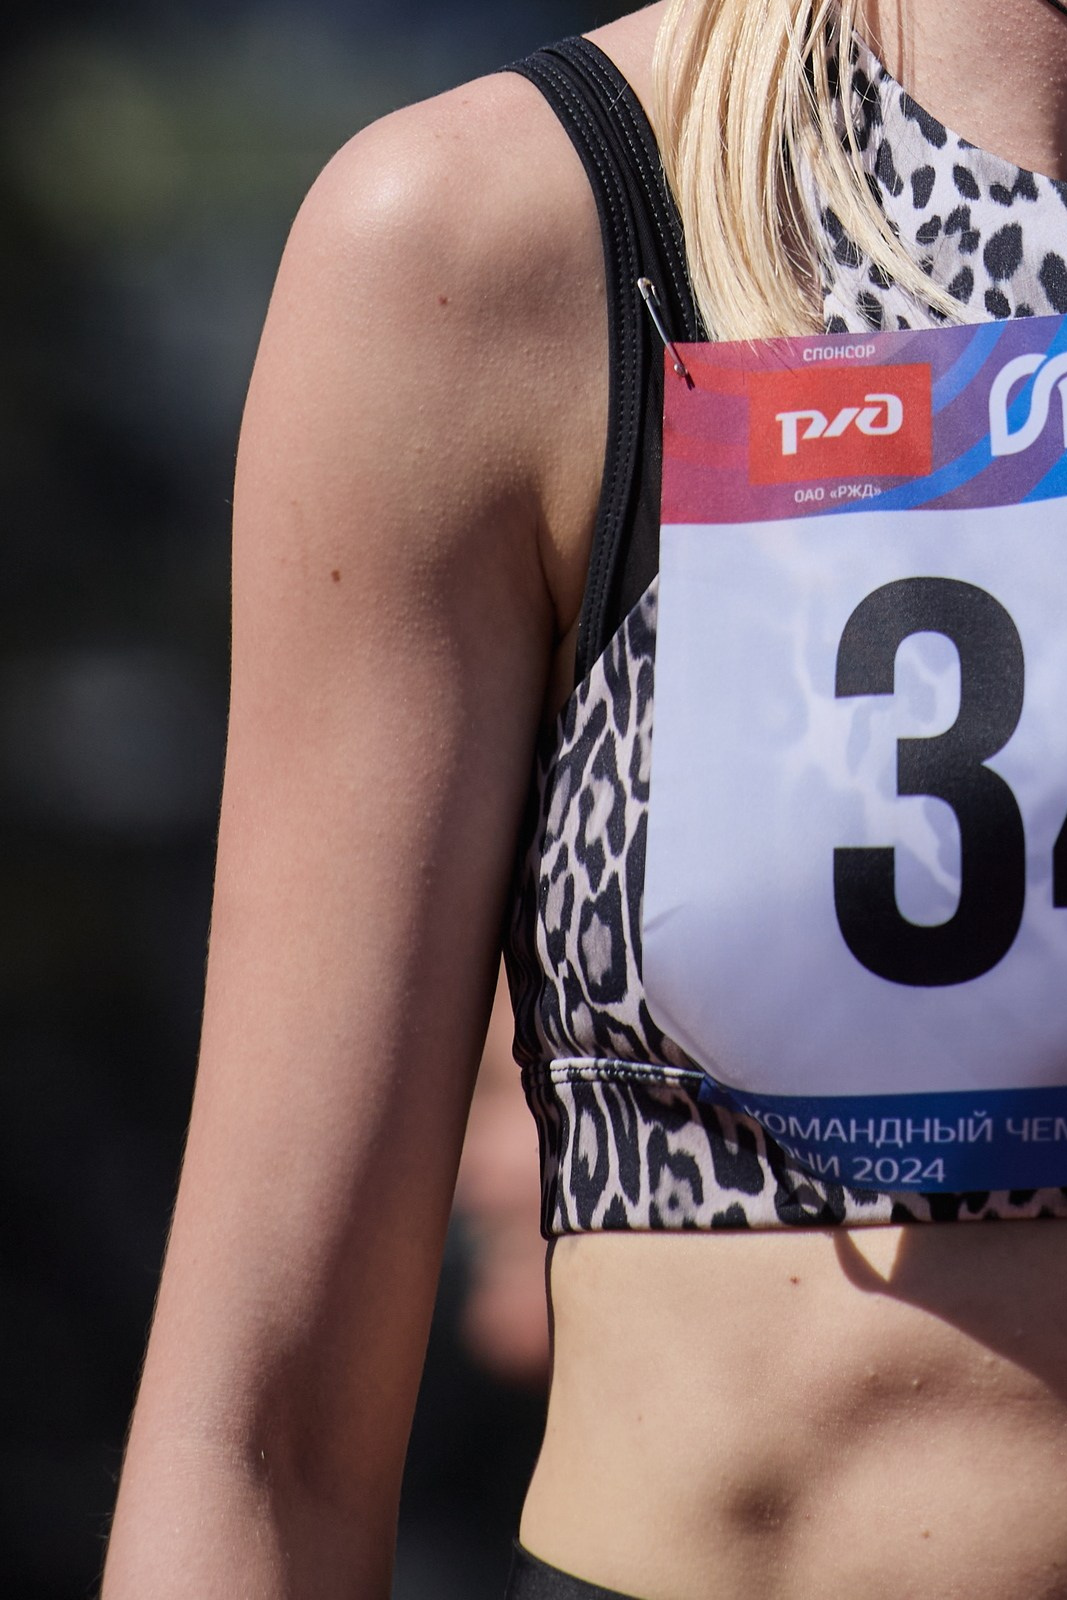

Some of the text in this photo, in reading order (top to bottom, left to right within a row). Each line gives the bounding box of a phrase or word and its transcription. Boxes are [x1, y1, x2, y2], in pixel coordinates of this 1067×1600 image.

[803, 345, 876, 361] СПОНСОР
[794, 484, 882, 502] ОАО «РЖД»
[852, 1156, 946, 1184] 2024
